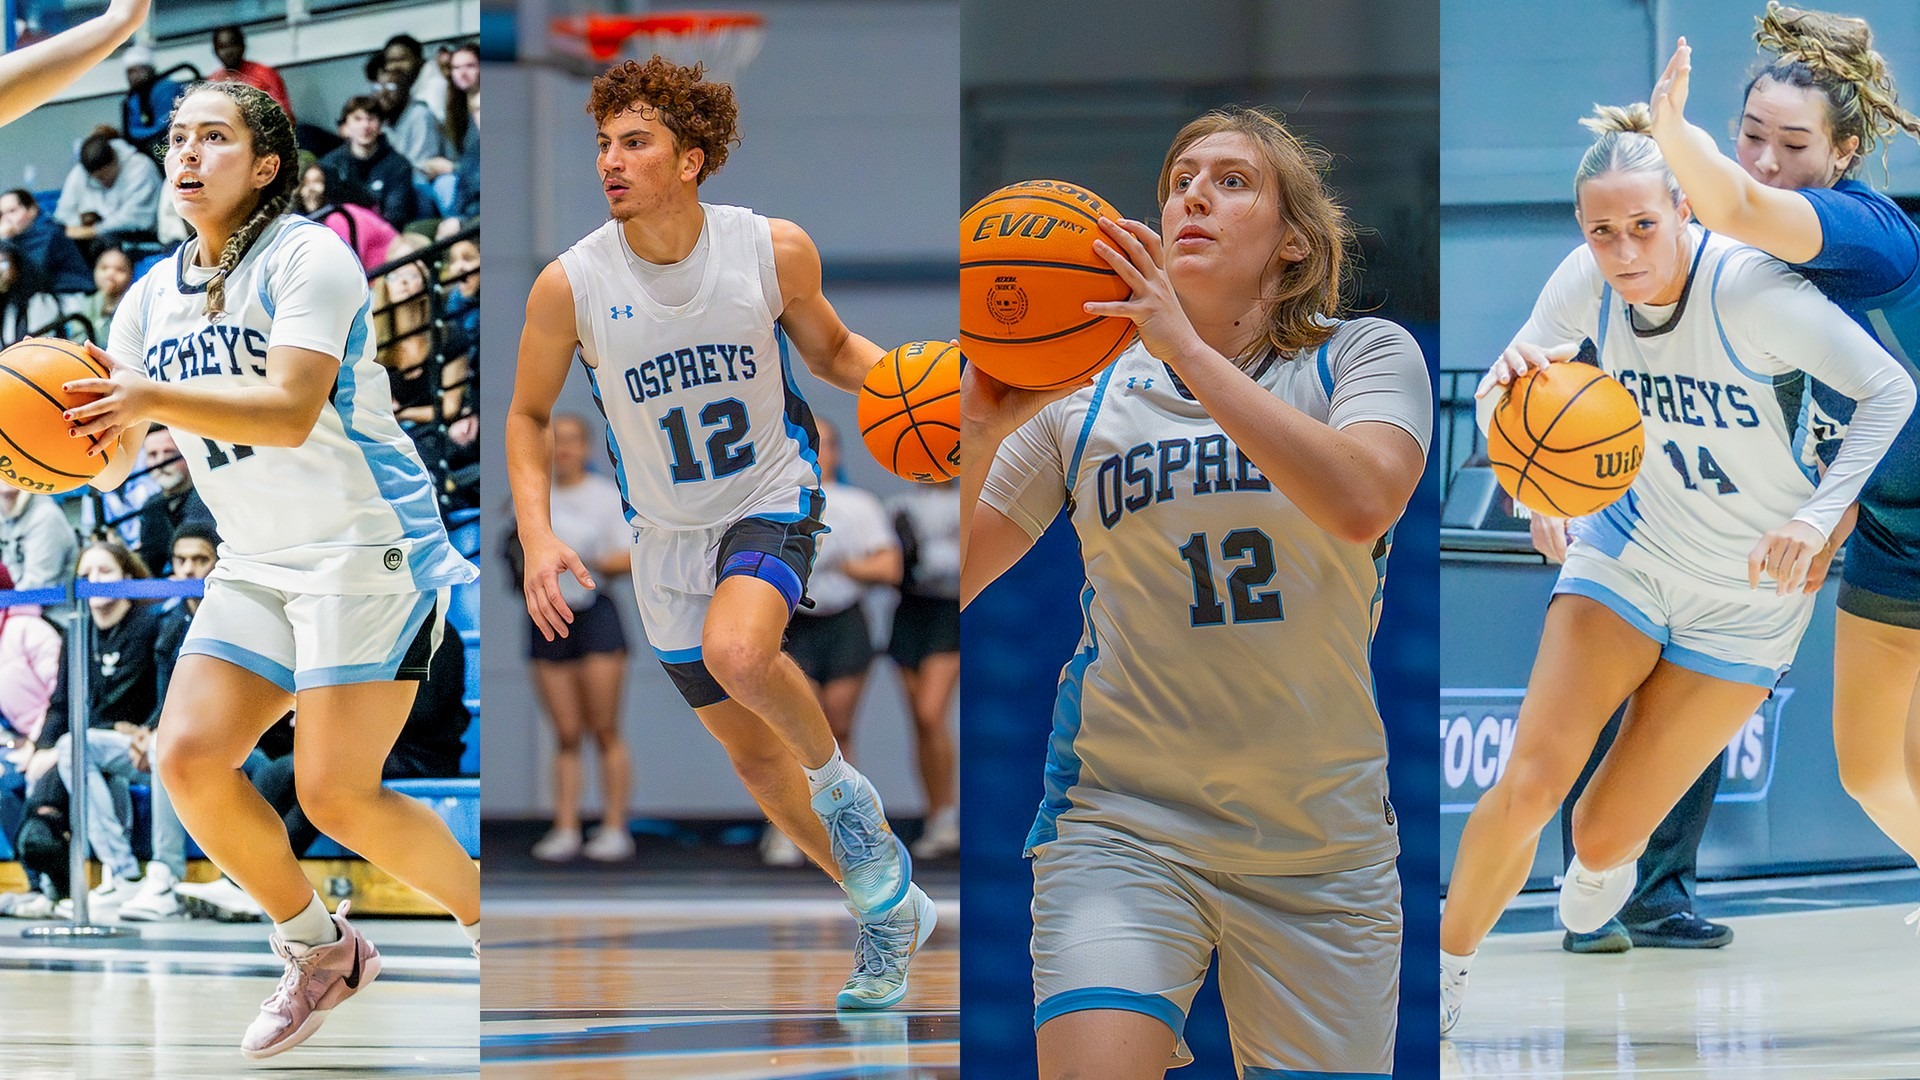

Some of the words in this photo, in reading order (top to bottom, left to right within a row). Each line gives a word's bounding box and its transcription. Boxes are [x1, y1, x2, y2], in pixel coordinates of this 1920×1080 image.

[1058, 220, 1088, 235] NXT
[144, 325, 267, 382] SPREYS
[624, 344, 757, 403] OSPREYS
[1613, 369, 1760, 428] SPREYS
[658, 397, 756, 484] 12
[1662, 439, 1740, 495] 14
[1098, 434, 1272, 530] OSPRE
[1178, 527, 1284, 627] 12
